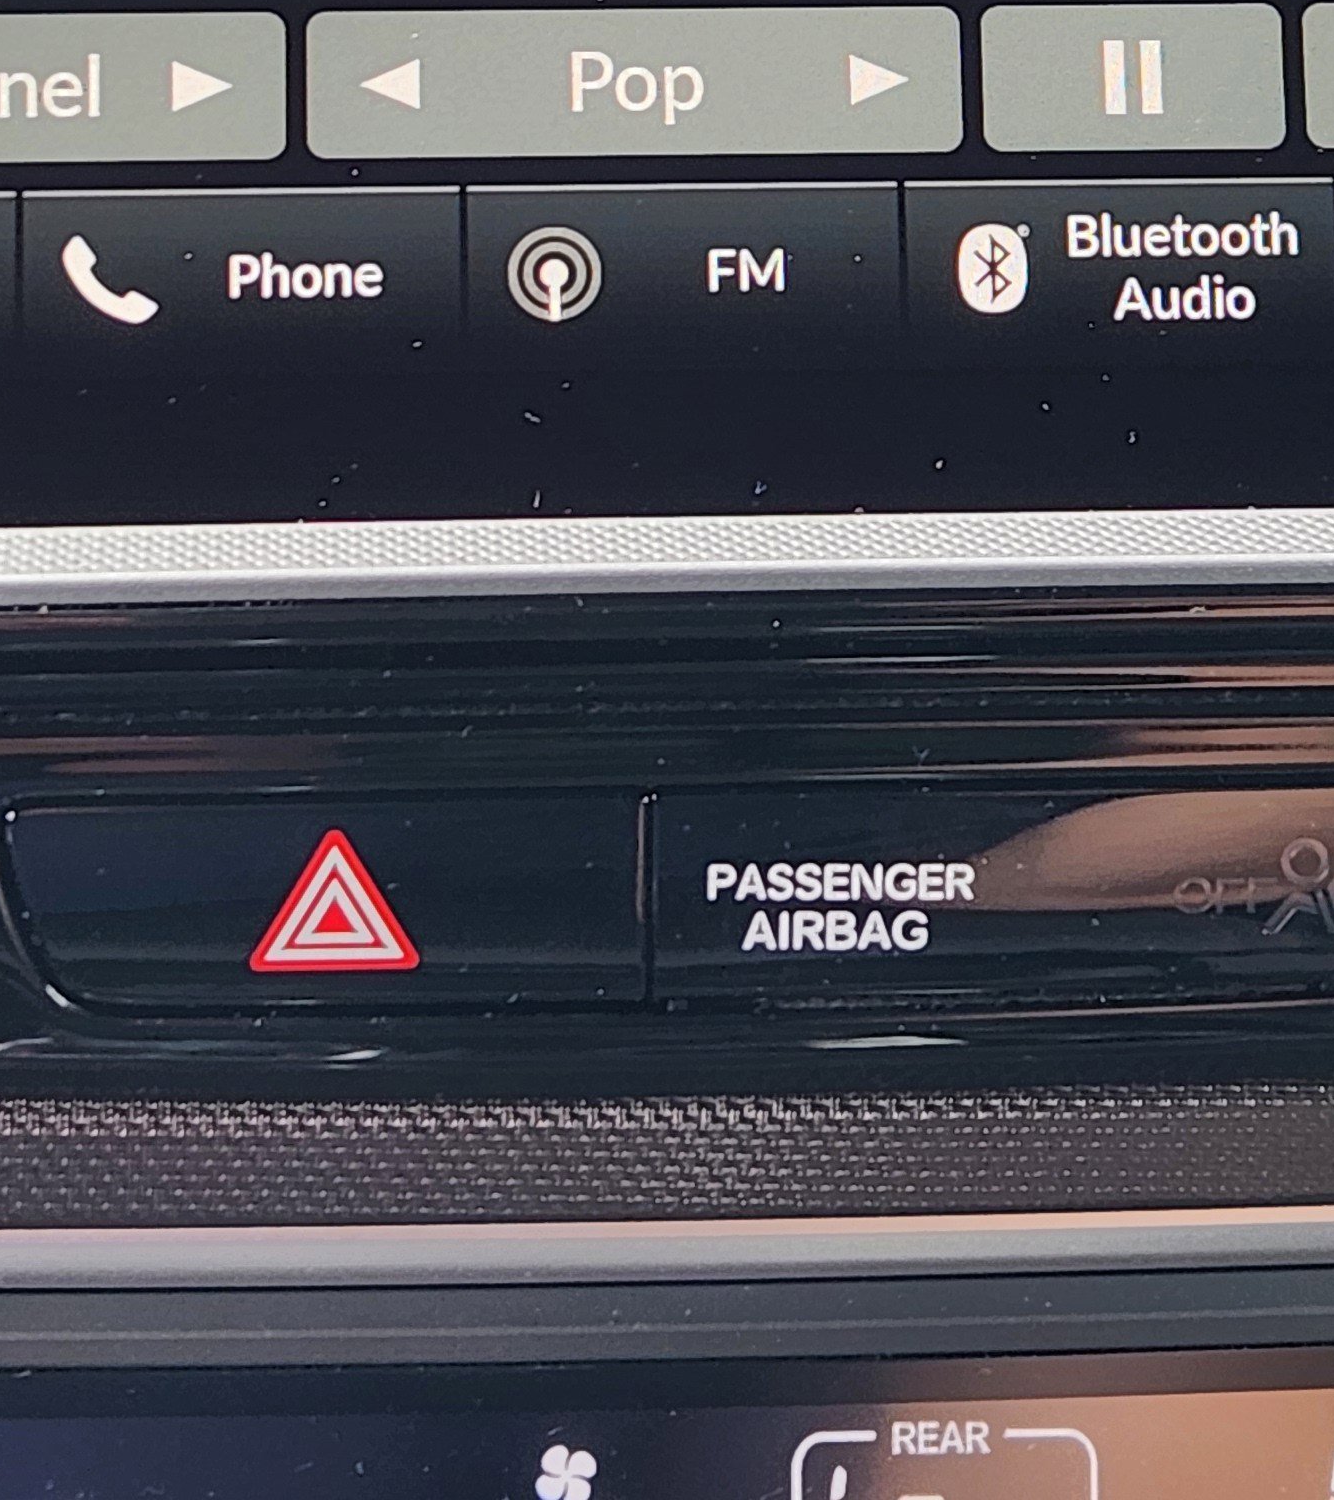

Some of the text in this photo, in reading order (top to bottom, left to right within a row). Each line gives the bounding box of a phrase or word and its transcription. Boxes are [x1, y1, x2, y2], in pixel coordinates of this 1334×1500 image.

[571, 51, 704, 126] Pop
[1067, 211, 1299, 258] Bluetooth
[229, 252, 384, 299] Phone
[708, 247, 785, 293] FM
[1113, 274, 1256, 321] Audio
[706, 862, 976, 902] PASSENGER
[741, 910, 929, 951] AIRBAG
[891, 1420, 992, 1456] REAR
